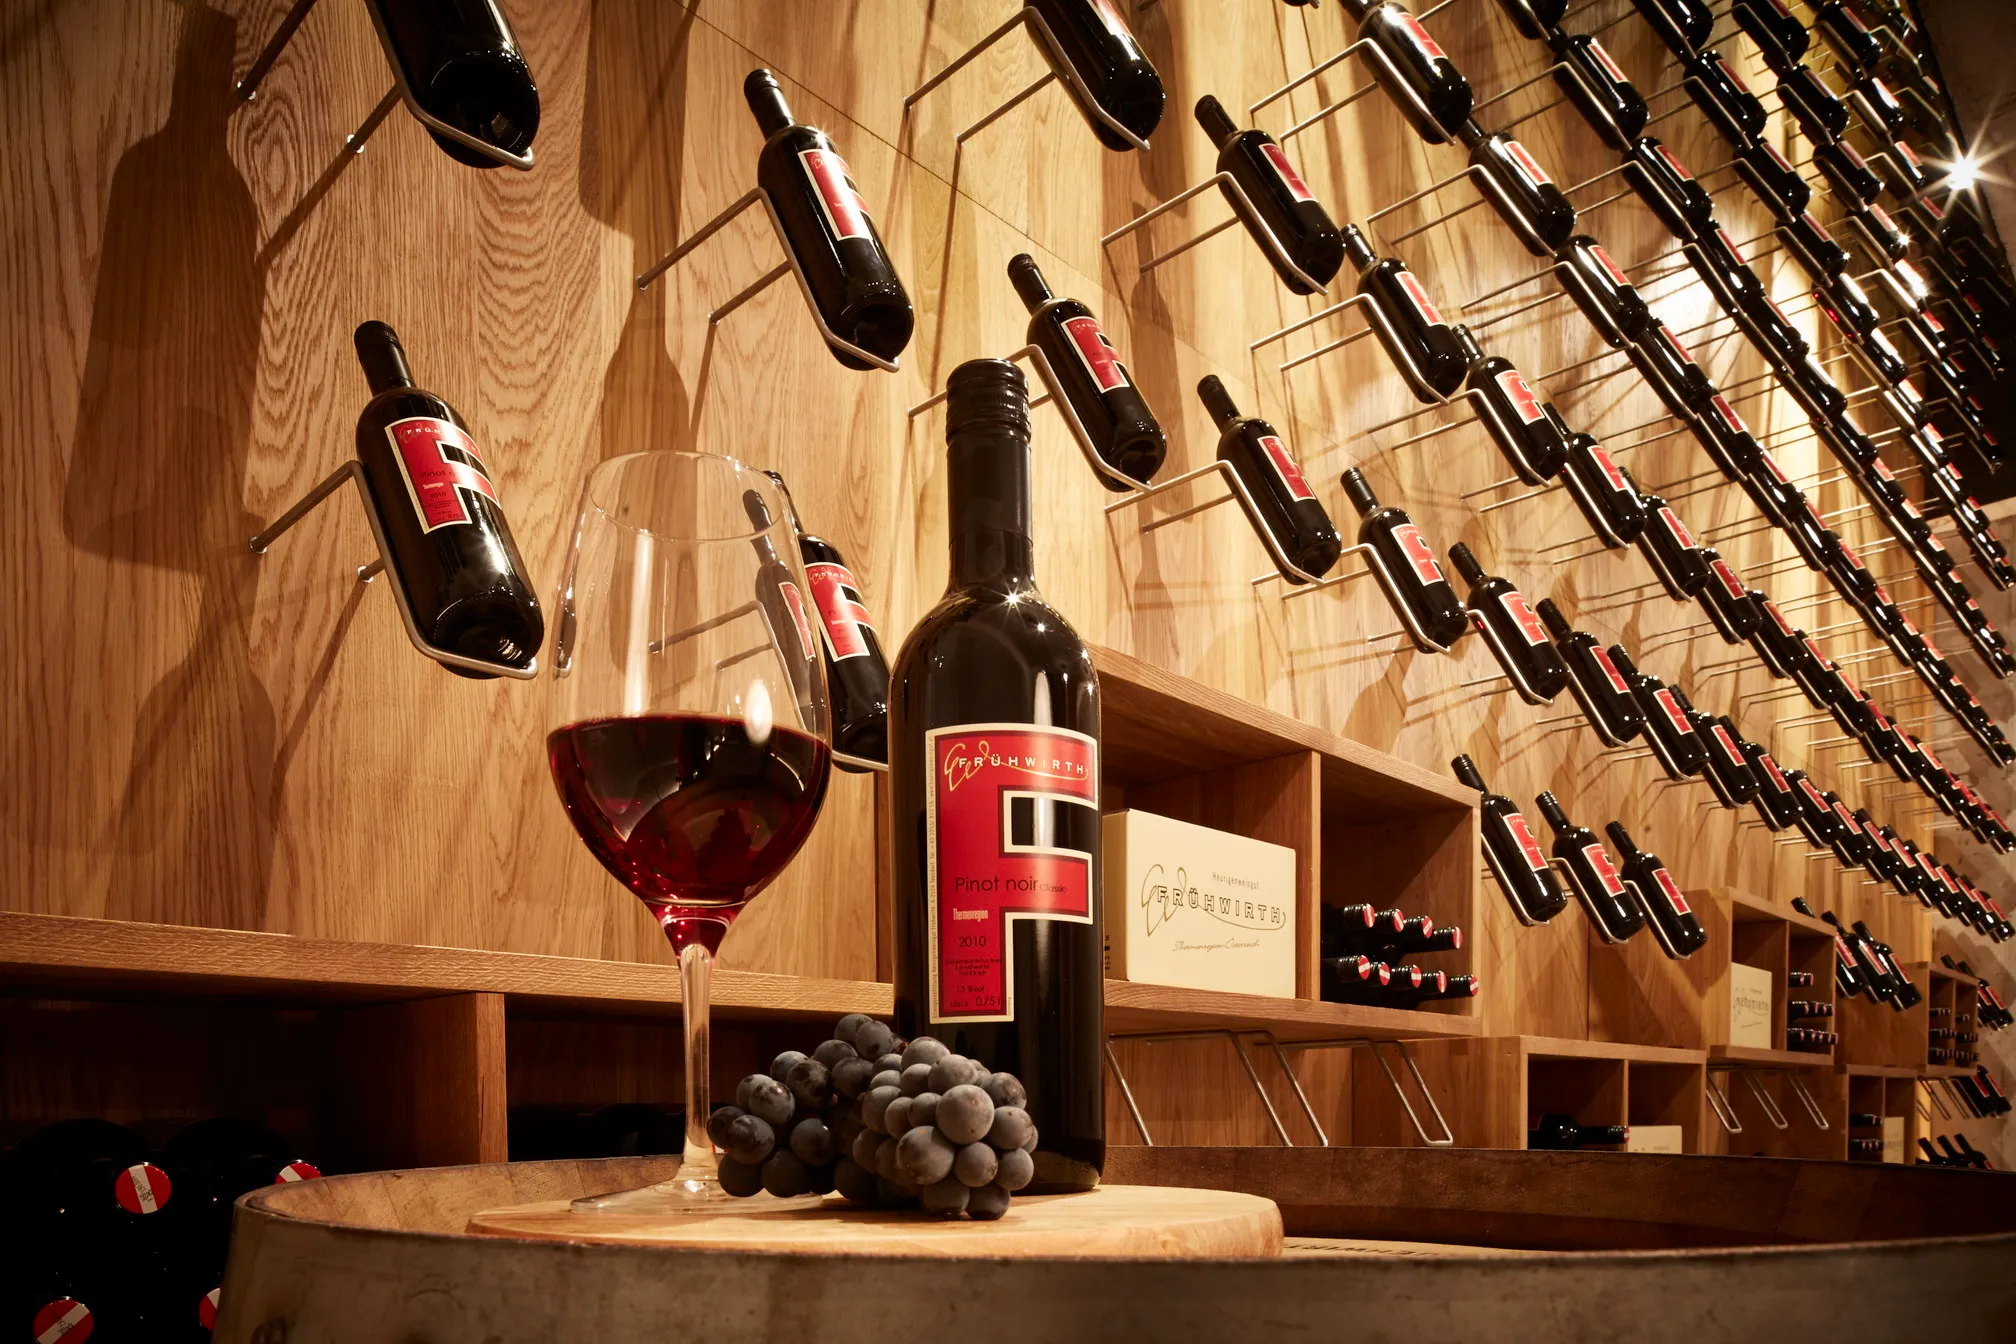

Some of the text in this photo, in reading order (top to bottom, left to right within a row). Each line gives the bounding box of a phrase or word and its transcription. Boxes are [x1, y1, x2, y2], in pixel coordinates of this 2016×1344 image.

[958, 754, 1084, 774] FRÜHWIRTH
[955, 876, 999, 893] Pinot
[1005, 876, 1038, 892] noir
[1156, 886, 1281, 924] FRÜHWIRTH
[959, 935, 987, 948] 2010
